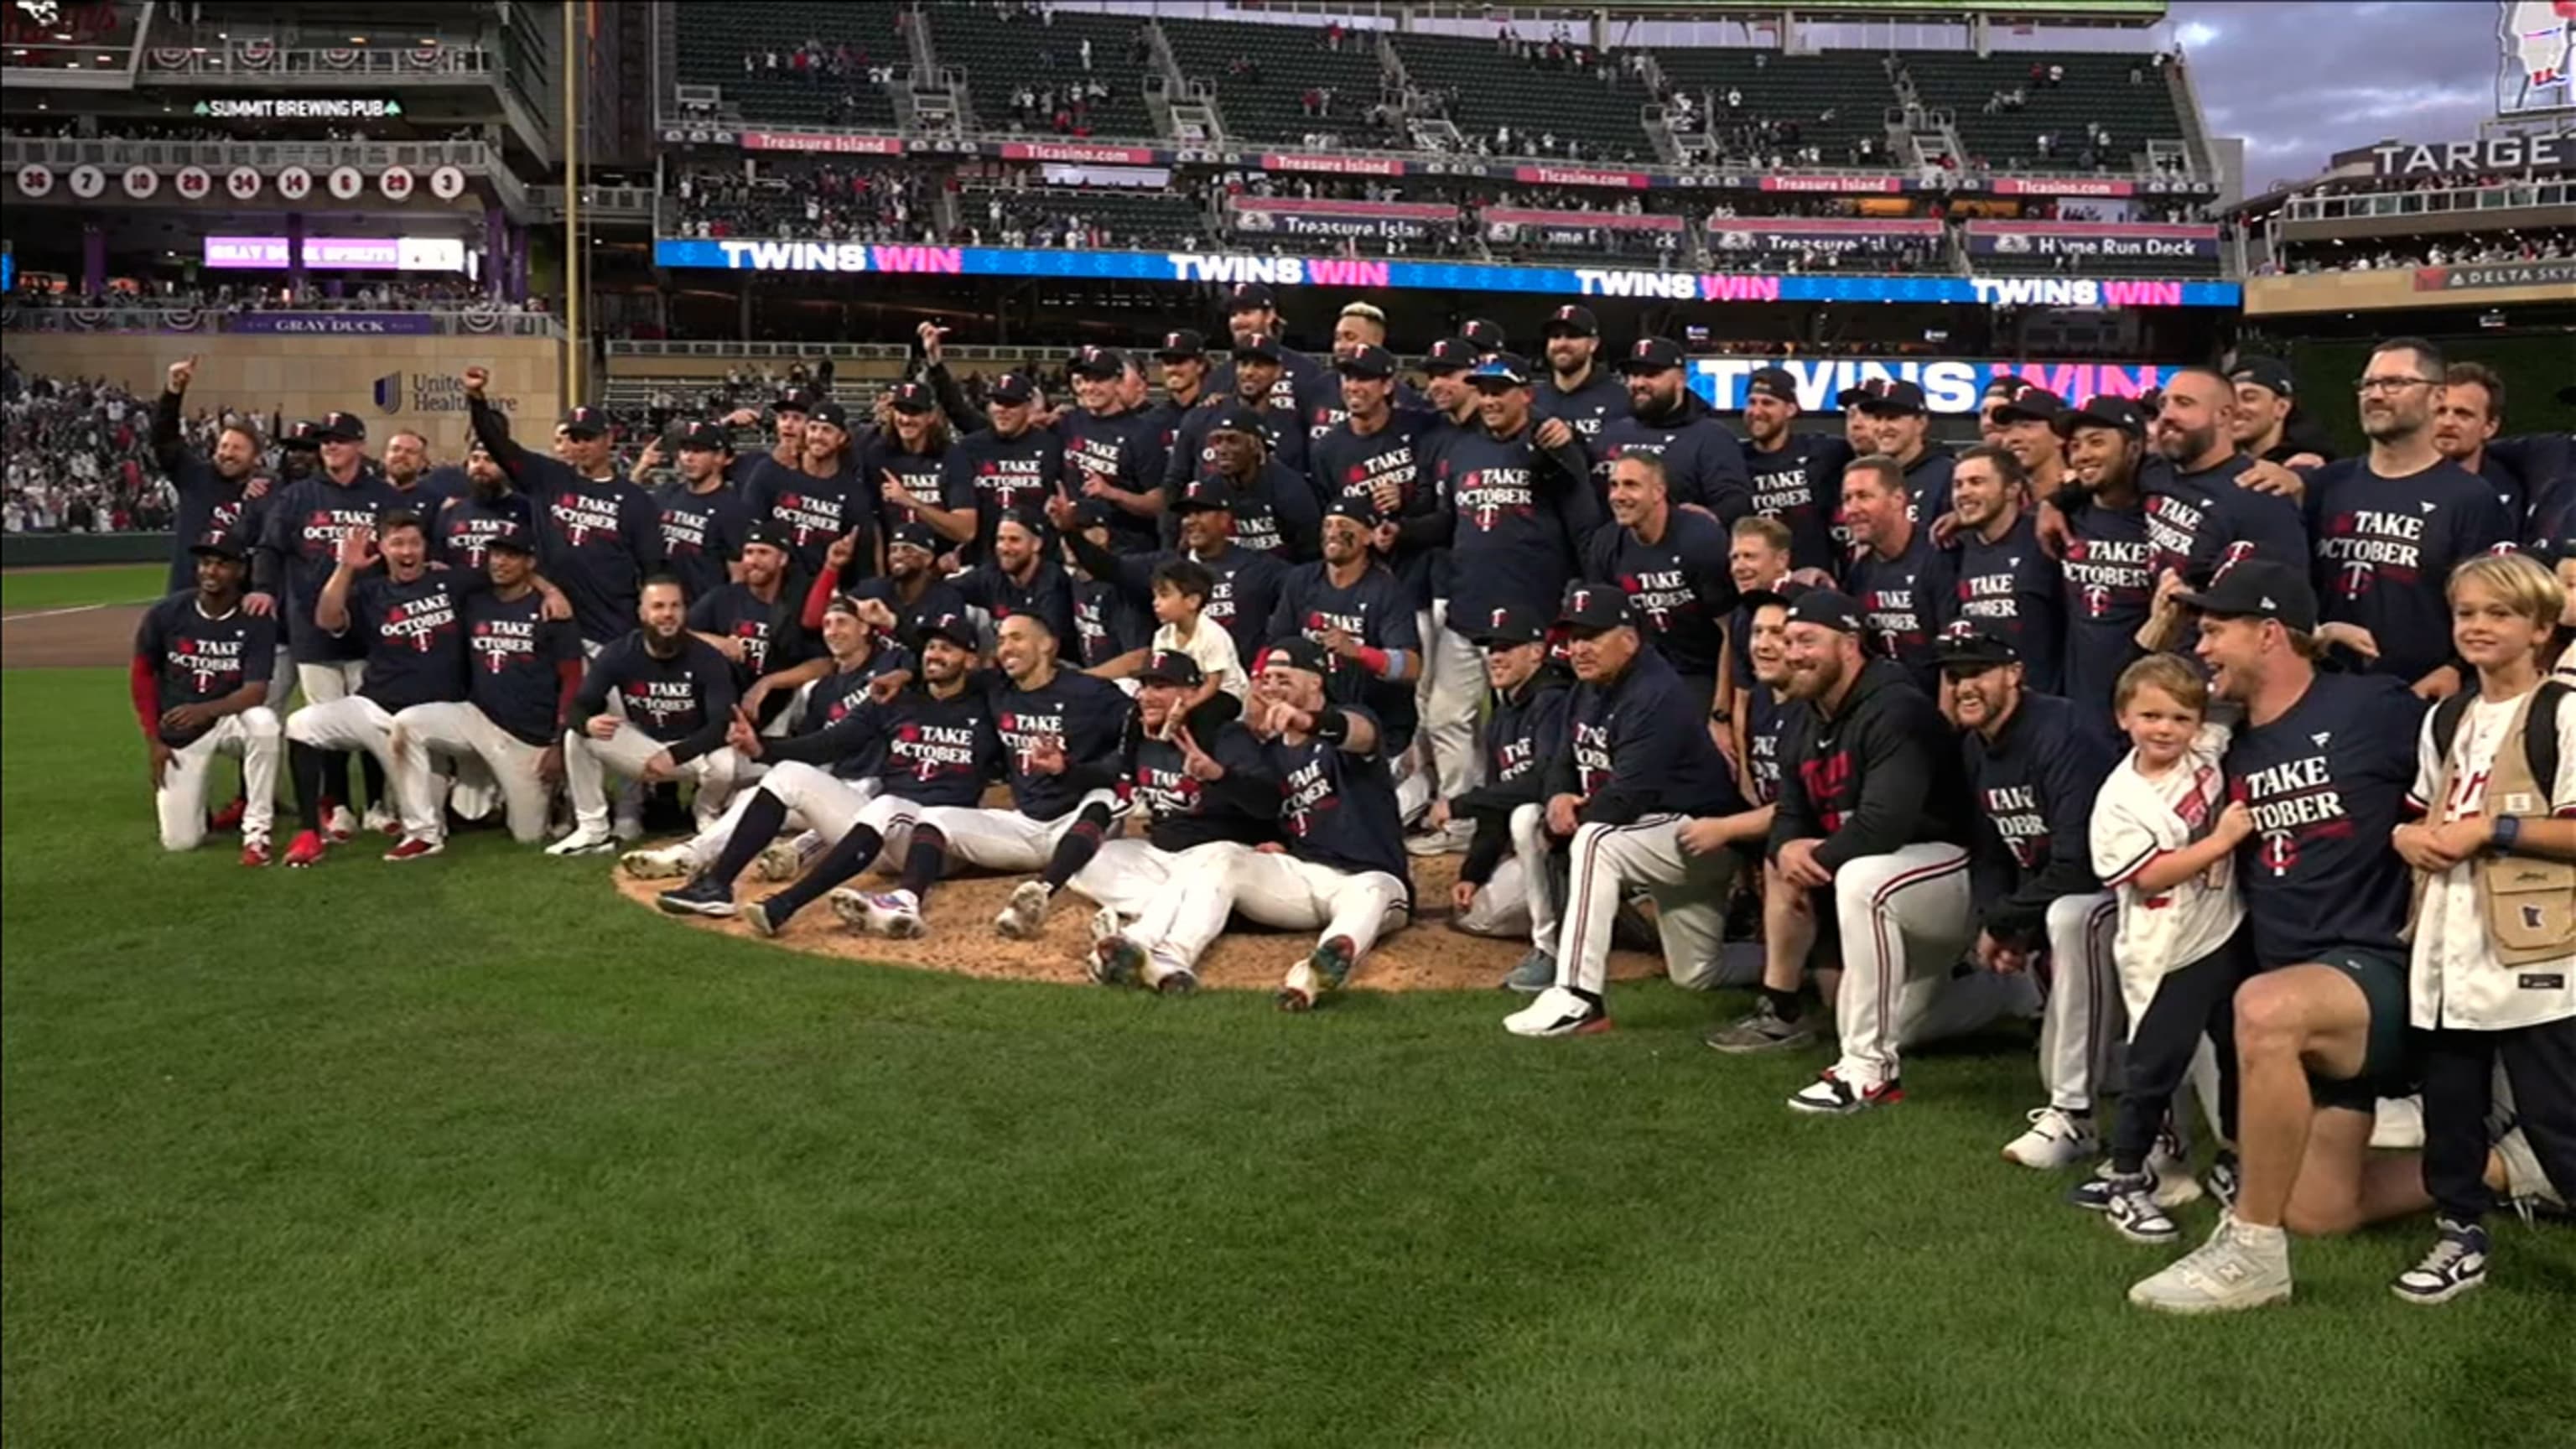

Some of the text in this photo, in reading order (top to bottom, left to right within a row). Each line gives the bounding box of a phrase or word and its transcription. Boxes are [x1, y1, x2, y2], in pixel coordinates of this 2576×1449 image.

[210, 100, 385, 117] SUMMIT BREWING PUB
[758, 133, 886, 153] Treasure Island
[2372, 132, 2576, 174] TARGE
[1275, 155, 1340, 172] Treasure
[80, 173, 93, 190] 7
[233, 174, 255, 190] 34
[286, 174, 305, 190] 14
[442, 174, 453, 190] 3
[1774, 178, 1837, 191] Treasure
[2039, 237, 2196, 255] Hme Run Deck
[719, 241, 962, 273] TWINS WIN
[1167, 254, 1389, 285] TWINS WIN
[2469, 269, 2532, 284] DELTA
[1574, 269, 1779, 301] TWINS WIN
[1970, 278, 2182, 305] TWINS WIN
[275, 318, 327, 332] GRAY
[332, 318, 384, 332] DUCK
[999, 460, 1041, 475] TAKE
[1363, 447, 1413, 472] TAKE
[901, 474, 940, 487] TAKE
[974, 474, 1042, 489] OCTOBER
[1481, 468, 1531, 485] TAKE
[1753, 470, 1809, 494] TAKE
[576, 494, 621, 517] TAKE
[800, 495, 844, 517] TAKE
[1454, 488, 1532, 505] OCTOBER
[331, 510, 377, 525] TAKE
[772, 506, 839, 533] OCTOBER
[2158, 496, 2204, 531] TAKE
[2354, 510, 2425, 541] TAKE
[2086, 541, 2148, 562] TAKE
[1637, 570, 1685, 590] TAKE
[1970, 573, 2014, 596] TAKE
[402, 592, 450, 615] TAKE
[1877, 590, 1914, 609] TAKE
[380, 609, 455, 636] OCTOBER
[491, 621, 534, 637] TAKE
[167, 652, 241, 671] OCTOBER
[648, 682, 693, 697] TAKE
[1015, 714, 1062, 733] TAKE
[920, 724, 974, 746] TAKE
[891, 738, 973, 765] OCTOBER
[2246, 756, 2331, 799] TAKE
[2250, 791, 2346, 834] TOBER
